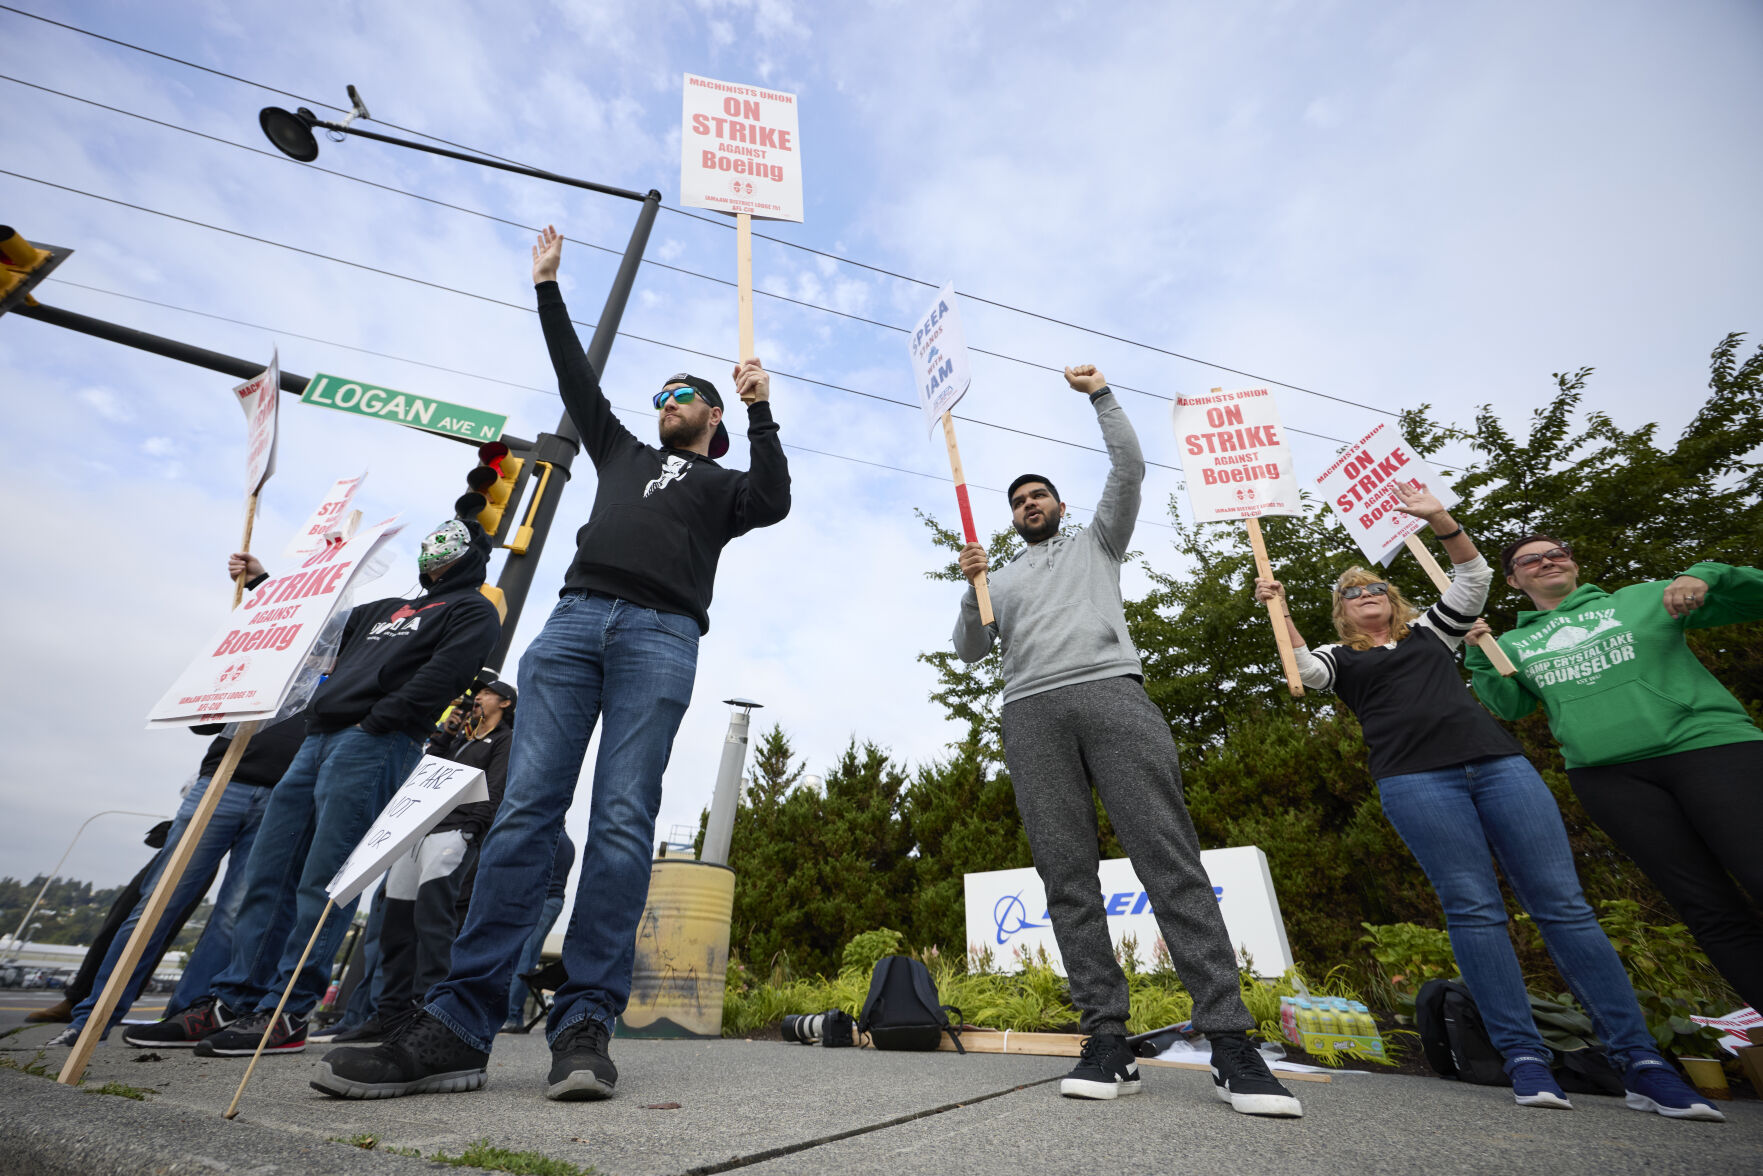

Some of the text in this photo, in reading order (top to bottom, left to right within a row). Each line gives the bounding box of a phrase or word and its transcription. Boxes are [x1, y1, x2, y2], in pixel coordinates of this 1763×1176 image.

[689, 77, 793, 104] MACHINISTS UNION
[723, 97, 761, 122] ON
[692, 113, 793, 152] STRIKE
[702, 150, 784, 182] Boeing
[718, 142, 767, 159] AGAINST
[925, 358, 953, 400] IAM
[927, 355, 943, 375] WITH
[310, 377, 495, 438] LOGAN AVE N
[1177, 388, 1268, 407] MACHINISTS UNION
[1206, 404, 1244, 428] ON
[1185, 425, 1280, 455] STRIKE
[1316, 423, 1385, 484] MACHINISTS UNION
[1202, 463, 1280, 485] Boeing
[1214, 452, 1259, 466] AGAINST
[1343, 449, 1375, 480] ON
[1336, 447, 1411, 513] STRIKE
[1359, 477, 1422, 530] Boeig
[243, 561, 352, 610] STRIKE
[248, 604, 302, 625] AGAINST
[212, 622, 304, 657] Boeing
[1512, 616, 1572, 649] SUMMER
[1524, 632, 1635, 679] CAMP CRYSTAL LAKE
[1534, 645, 1636, 689] COUNSELOR
[419, 765, 464, 790] ARE
